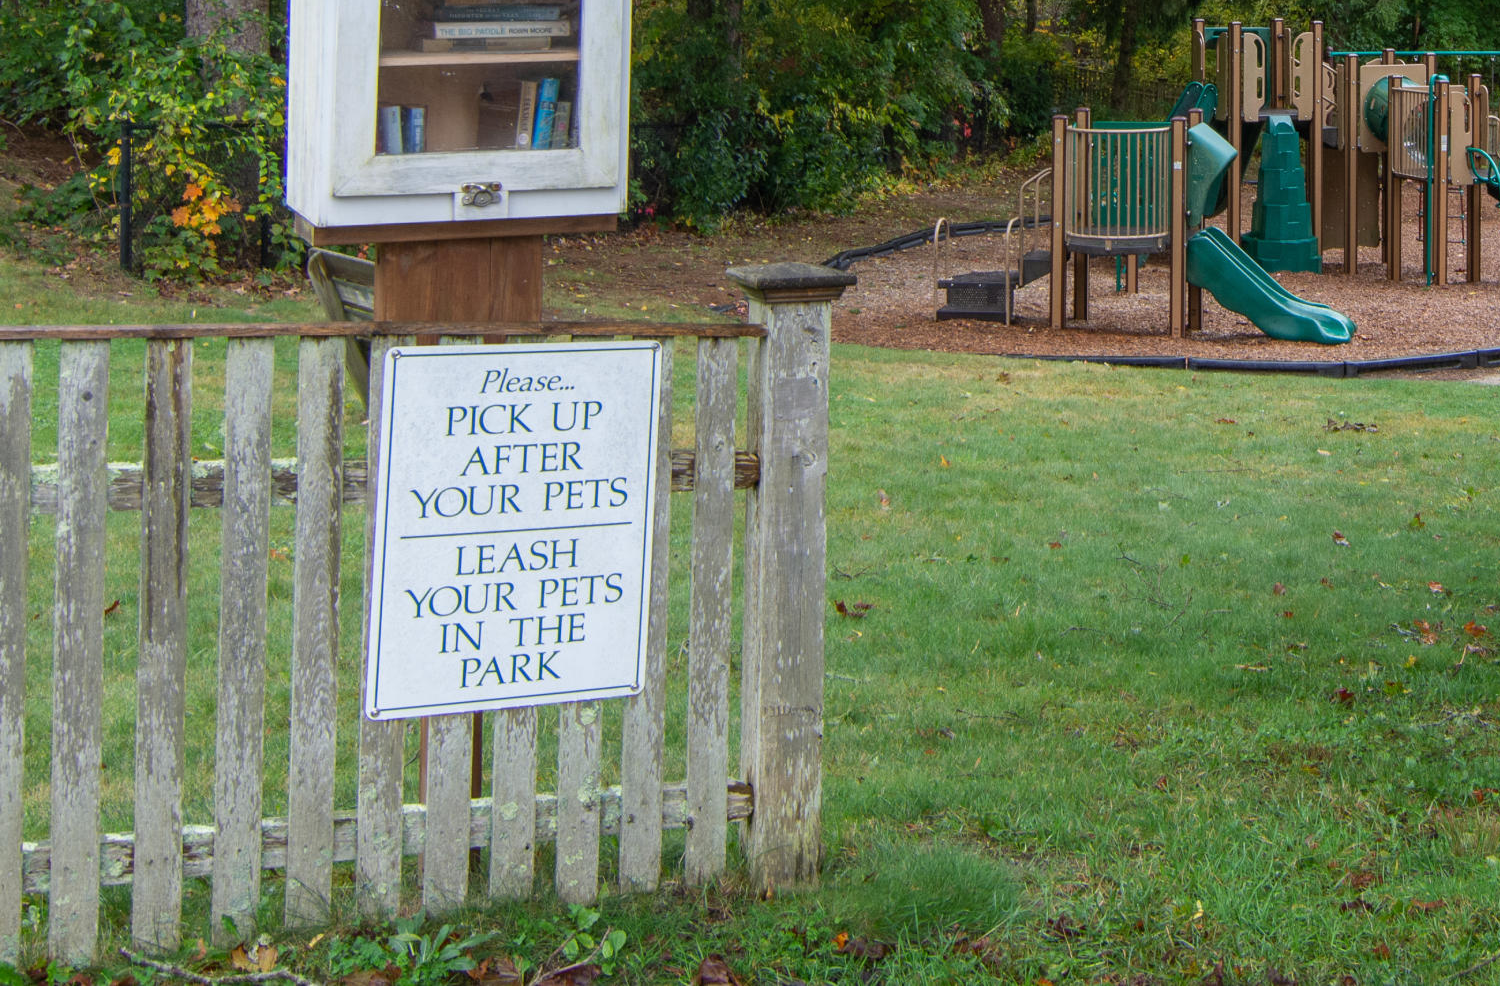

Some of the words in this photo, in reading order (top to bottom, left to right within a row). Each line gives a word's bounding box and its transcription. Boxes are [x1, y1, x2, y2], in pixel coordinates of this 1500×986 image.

[475, 27, 506, 35] PADDLE
[481, 368, 574, 393] Please...
[447, 404, 532, 436] PICK
[553, 401, 602, 431] UP
[460, 442, 583, 476] AFTER
[410, 484, 522, 518] YOUR
[544, 477, 627, 511] PETS
[456, 539, 578, 576] LEASH
[405, 582, 518, 618] YOUR
[539, 573, 623, 608] PETS
[440, 621, 486, 654] IN
[509, 613, 586, 646] THE
[459, 650, 561, 689] PARK
